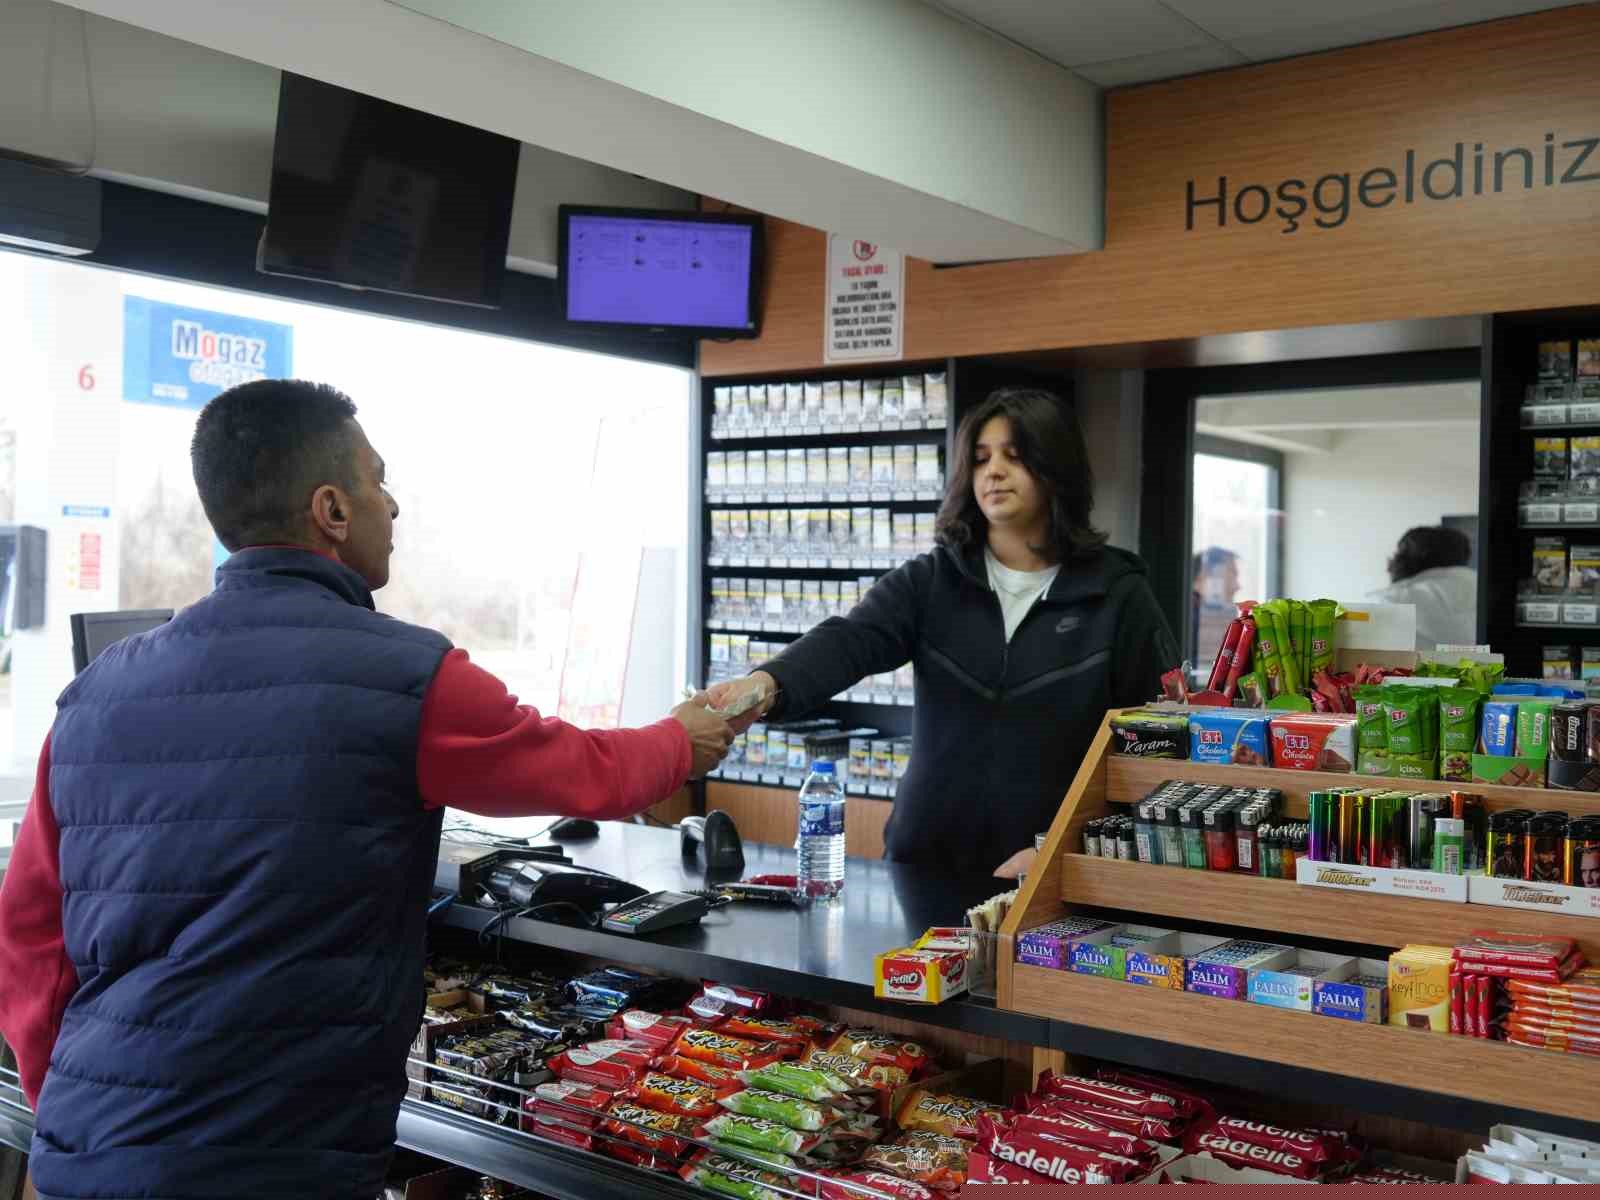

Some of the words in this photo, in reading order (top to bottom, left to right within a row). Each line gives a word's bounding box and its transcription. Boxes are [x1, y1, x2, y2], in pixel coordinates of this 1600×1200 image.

[1184, 133, 1600, 233] Hoşgeldiniz
[175, 324, 263, 366] Mogaz
[78, 365, 96, 391] 6
[1123, 739, 1176, 754] Karam
[1020, 943, 1054, 958] FALIM
[1075, 951, 1110, 966] FALIM
[1130, 961, 1167, 976] FALIM
[1191, 970, 1230, 987] FALIM
[1317, 992, 1360, 1009] FALIM
[991, 1135, 1081, 1185] tadelle
